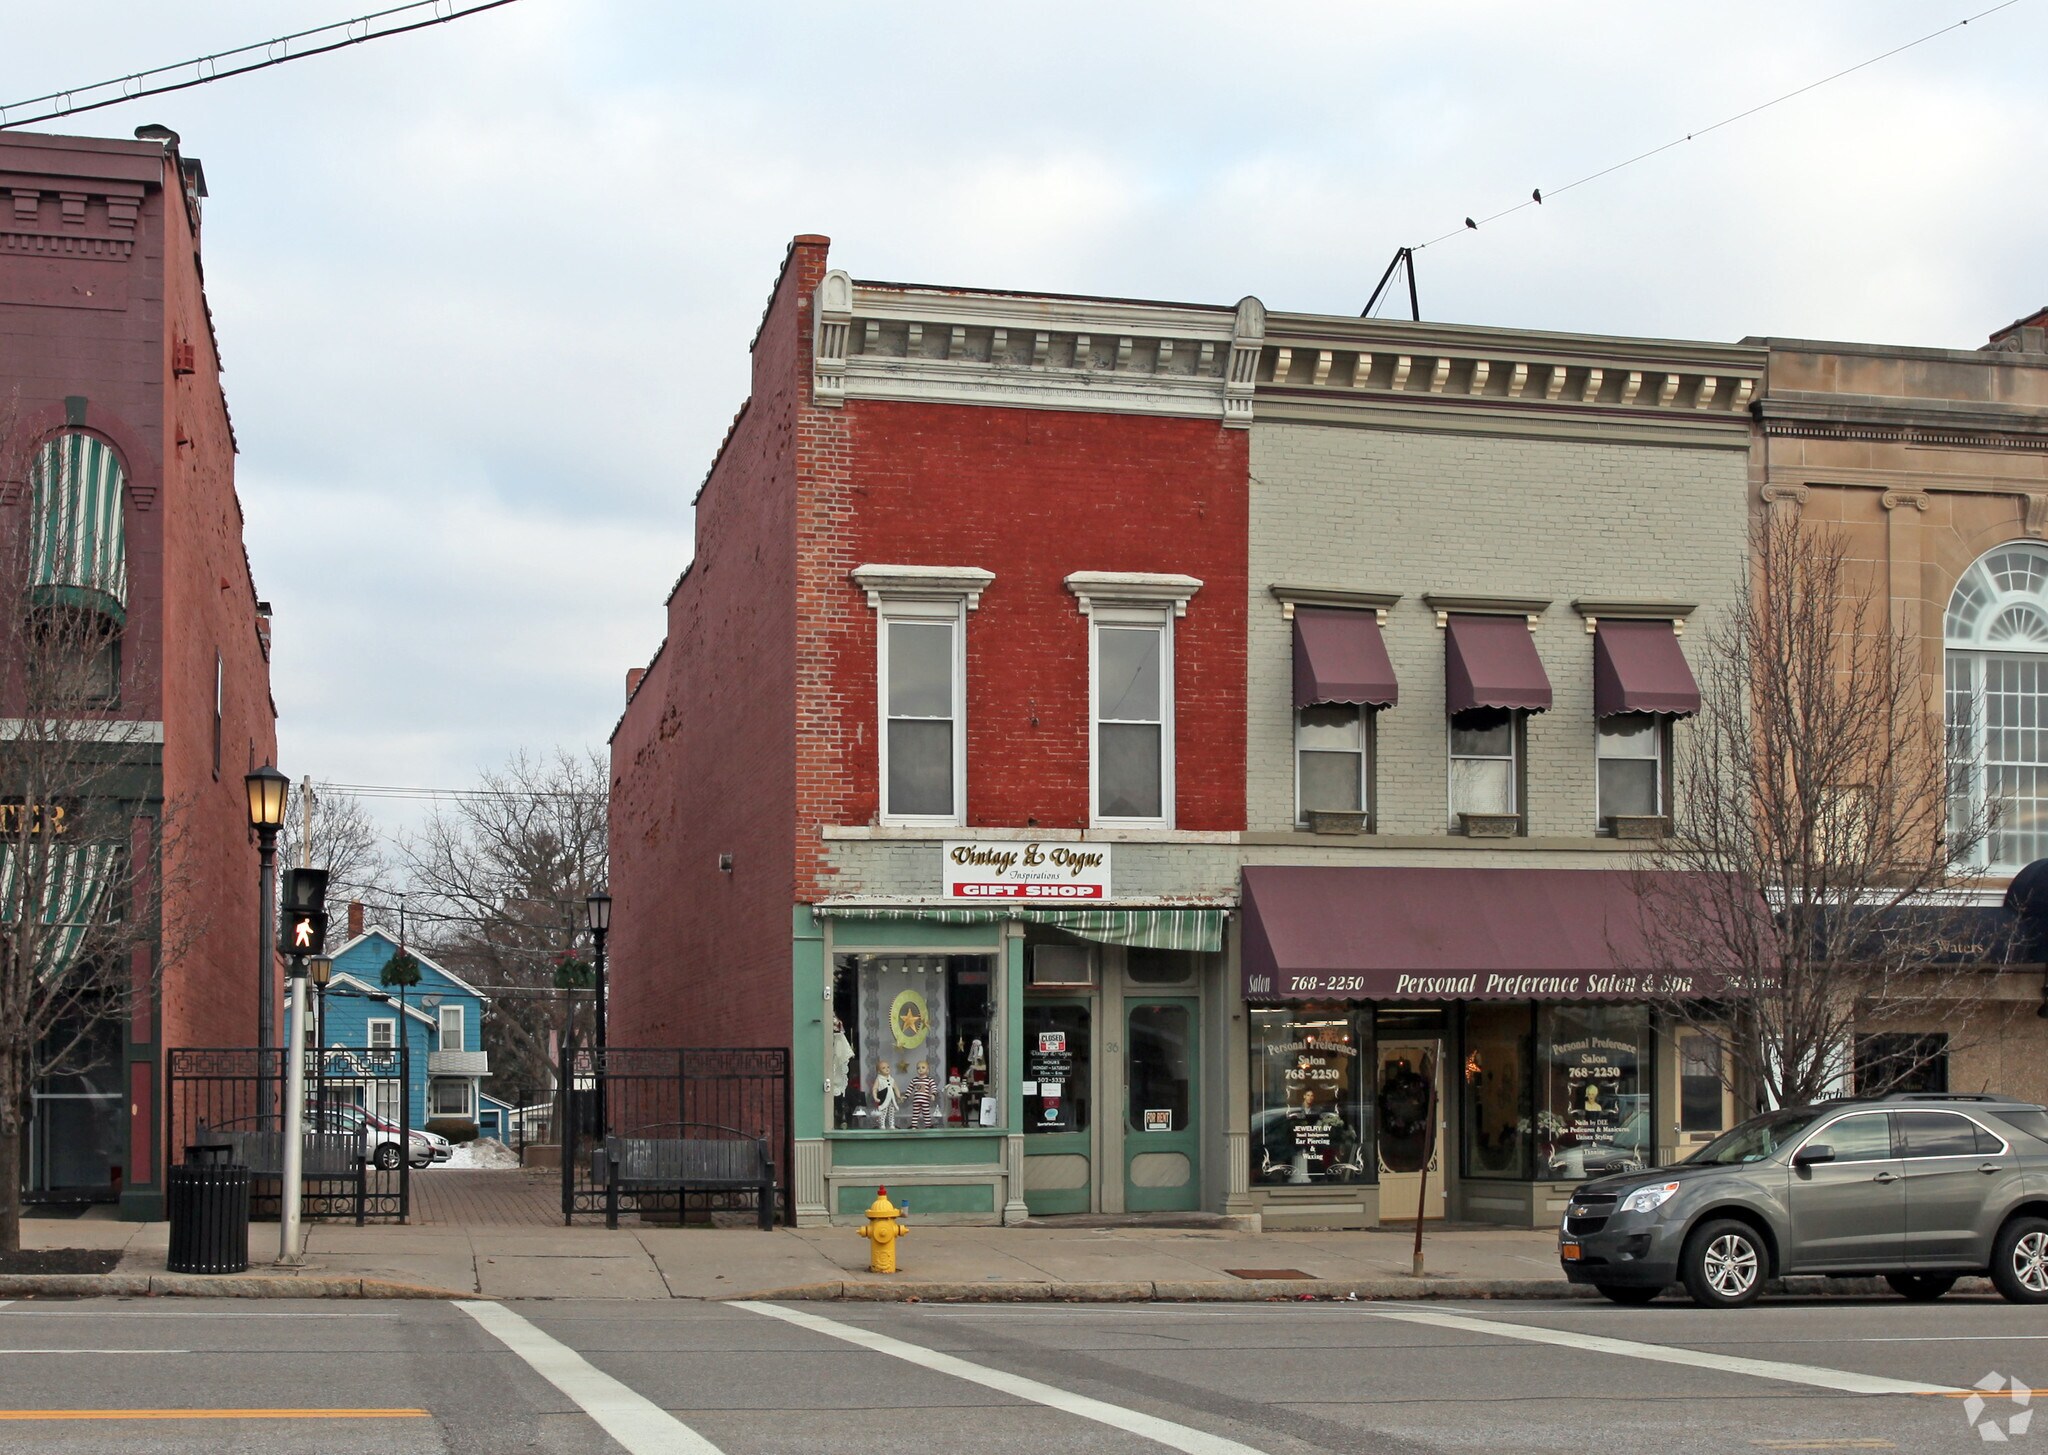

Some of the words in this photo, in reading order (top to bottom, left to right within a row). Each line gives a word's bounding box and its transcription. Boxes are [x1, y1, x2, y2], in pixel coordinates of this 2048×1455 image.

[950, 845, 1018, 876] Vintage
[1022, 843, 1045, 867] &
[1049, 847, 1103, 877] Vogue
[1009, 870, 1060, 884] Inspirations
[962, 885, 1019, 896] GIFT
[1025, 886, 1094, 897] SHOP
[1248, 974, 1270, 993] Salon
[1291, 976, 1364, 991] 768-2250
[1396, 973, 1477, 993] Personal
[1485, 973, 1579, 995] Preference
[1586, 974, 1635, 993] Salon
[1641, 973, 1654, 993] &
[1041, 1034, 1064, 1042] CLOSED
[1106, 1042, 1119, 1053] 36
[1267, 1039, 1307, 1056] Personal
[1309, 1038, 1357, 1057] Preference
[1552, 1038, 1589, 1055] Personal
[1591, 1037, 1637, 1054] Preference
[1298, 1055, 1326, 1066] Salon
[1581, 1054, 1607, 1064] Salon
[1284, 1069, 1340, 1080] 768-2250
[1568, 1067, 1621, 1077] 768-2250
[1147, 1112, 1156, 1123] FOR
[1157, 1112, 1169, 1122] RENT
